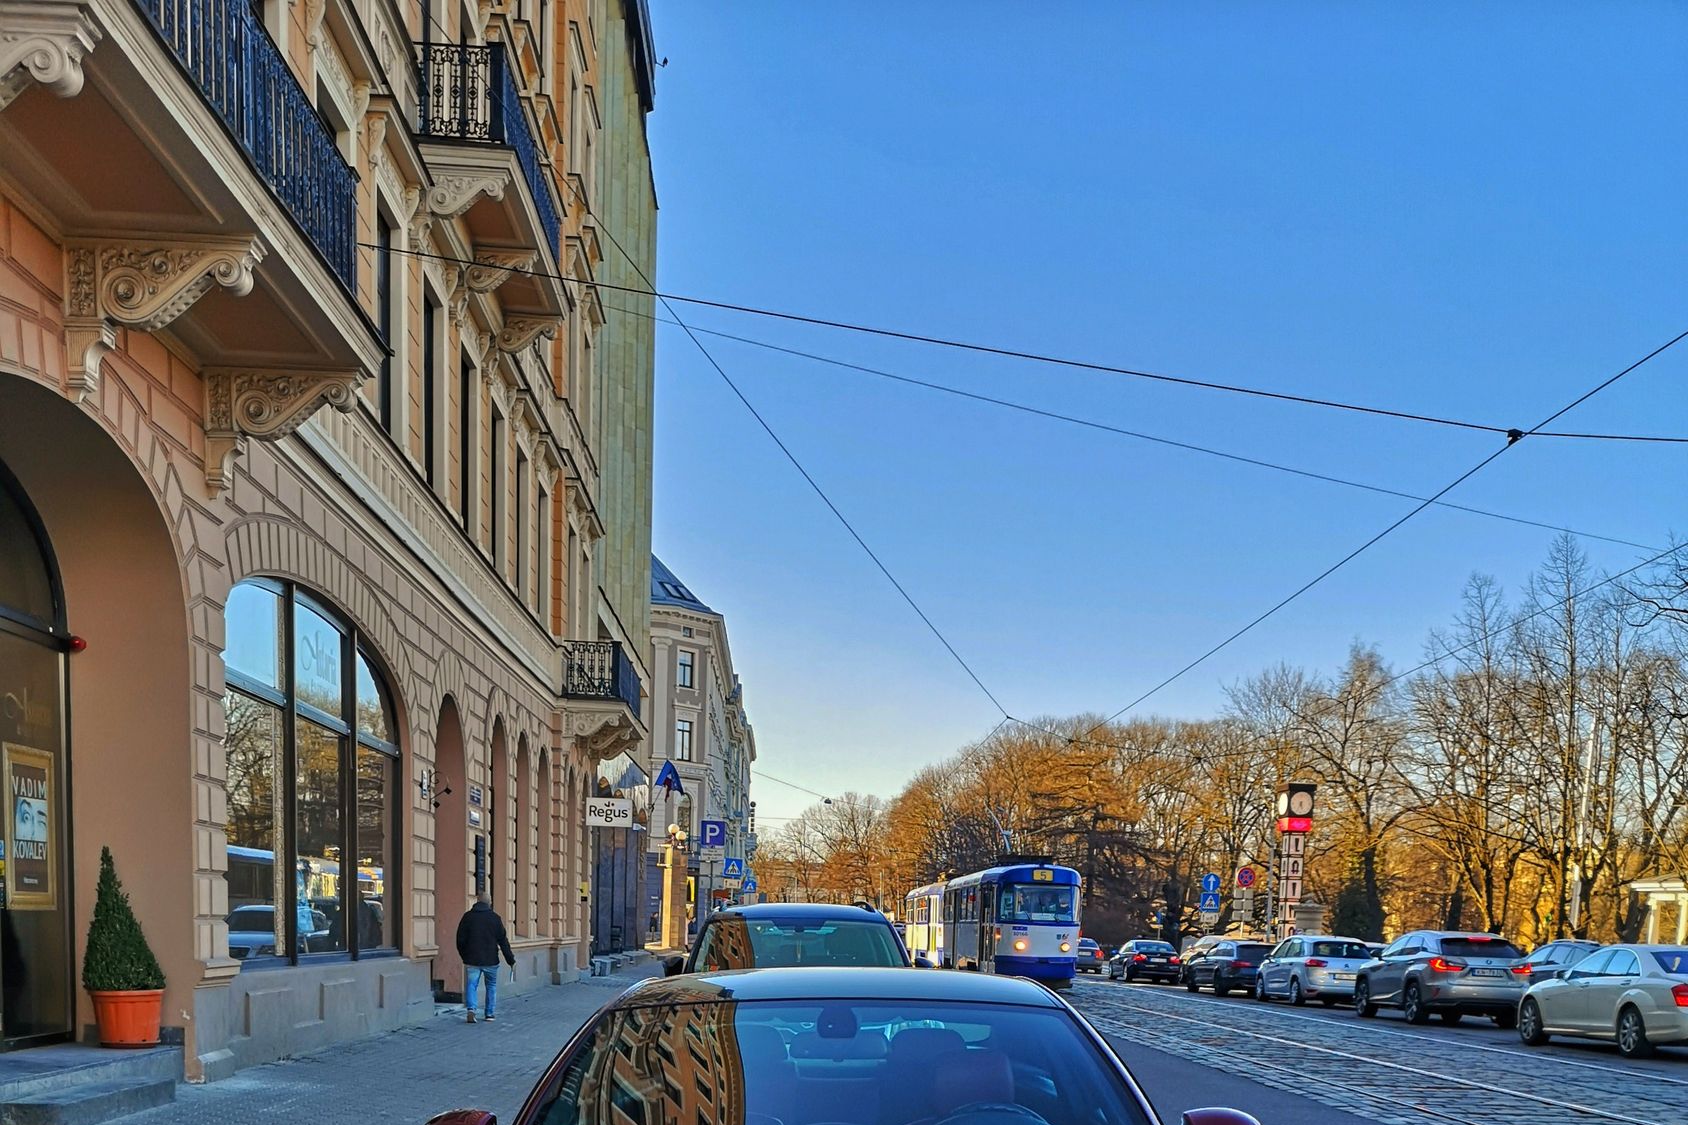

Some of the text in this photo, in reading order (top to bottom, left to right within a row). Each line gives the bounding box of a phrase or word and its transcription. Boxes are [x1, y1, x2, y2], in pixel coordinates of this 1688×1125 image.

[11, 775, 47, 798] VADIM
[588, 804, 629, 823] Regus
[705, 824, 720, 844] P
[13, 840, 47, 861] KOVALEV
[1040, 871, 1047, 880] 5
